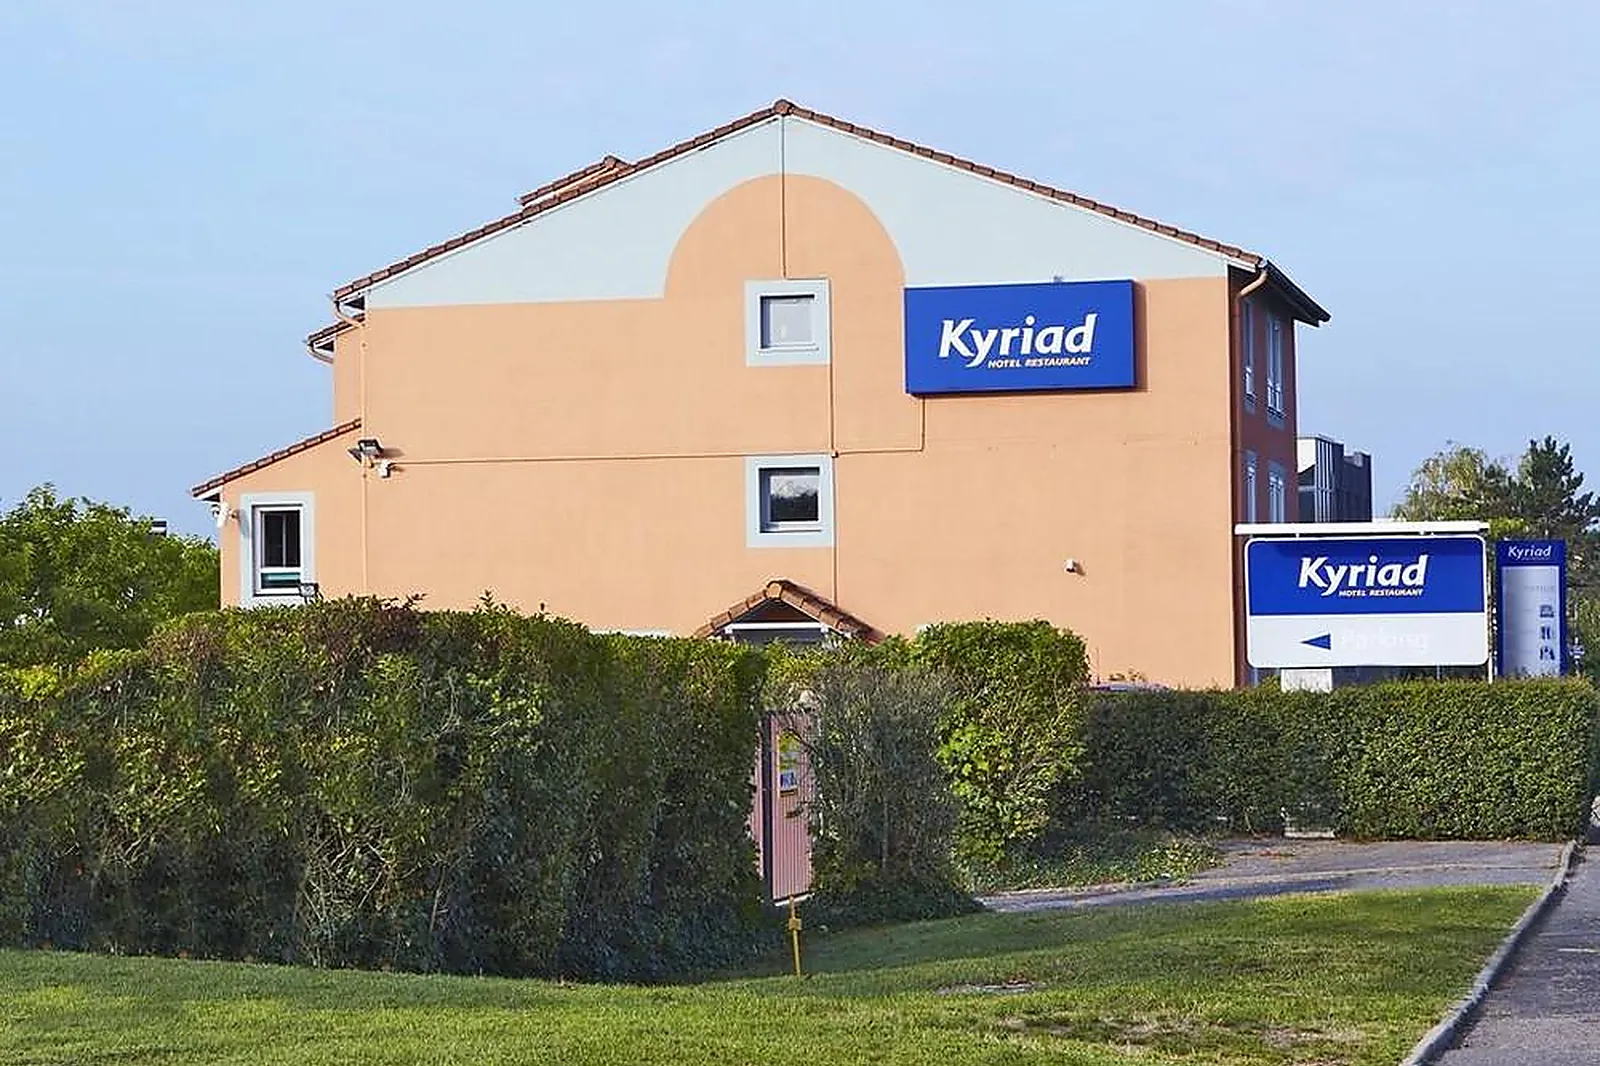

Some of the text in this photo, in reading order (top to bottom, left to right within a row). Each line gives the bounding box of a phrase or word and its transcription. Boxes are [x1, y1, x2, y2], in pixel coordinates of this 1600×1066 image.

[938, 313, 1098, 368] Kyriad
[988, 357, 1091, 369] HOTEL RESTAURANT
[1508, 545, 1552, 560] Kyriad
[1298, 554, 1428, 596] Kyriad
[1369, 588, 1424, 597] RESTAURANT
